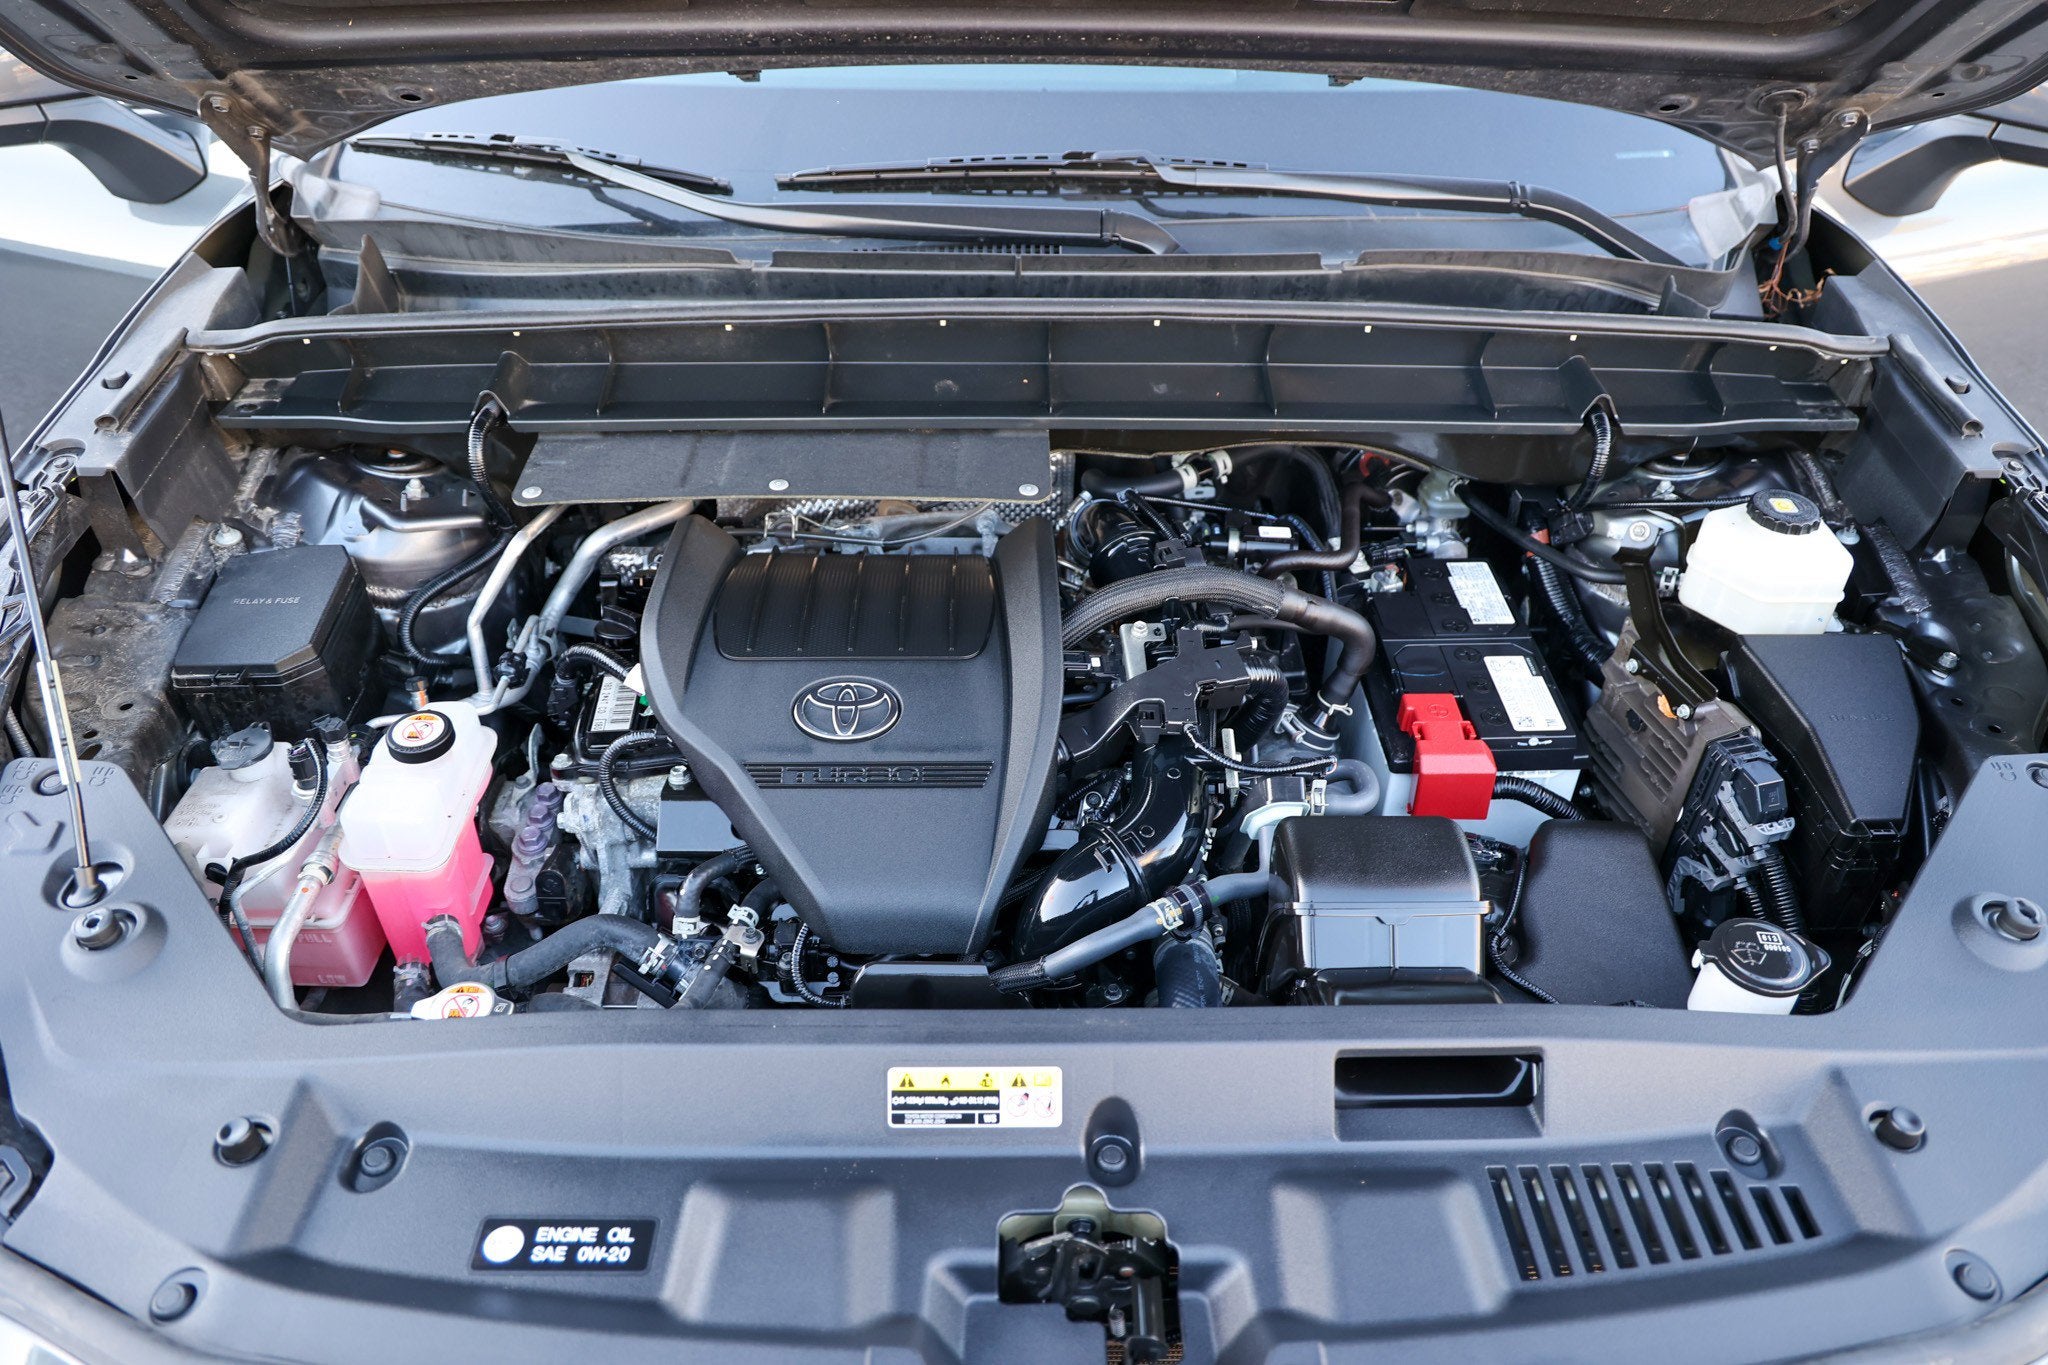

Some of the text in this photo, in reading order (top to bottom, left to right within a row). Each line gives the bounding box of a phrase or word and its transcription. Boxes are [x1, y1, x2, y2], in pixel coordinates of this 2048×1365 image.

[233, 597, 265, 605] RELAY
[274, 596, 301, 604] FUSE
[786, 766, 920, 783] TURBO
[535, 1226, 635, 1243] ENGINE OIL
[530, 1245, 631, 1262] SAE 0W-20
